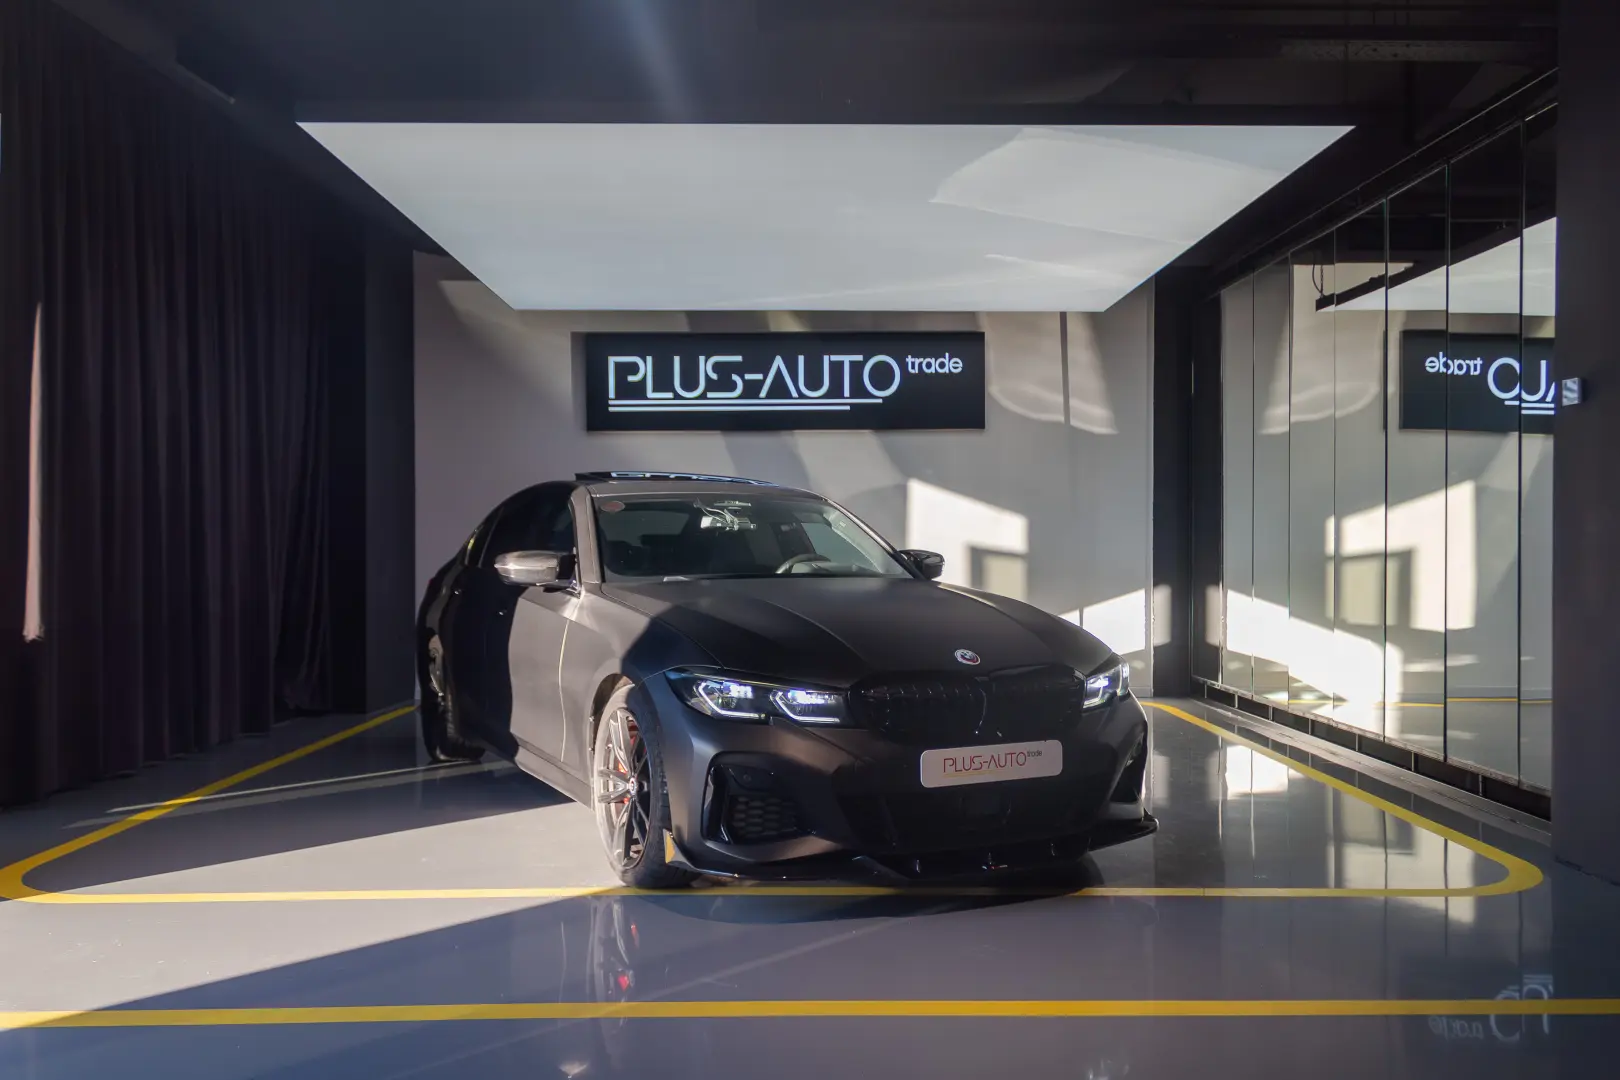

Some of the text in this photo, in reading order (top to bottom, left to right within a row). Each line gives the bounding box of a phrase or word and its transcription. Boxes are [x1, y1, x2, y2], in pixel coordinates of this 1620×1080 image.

[607, 352, 963, 399] PLUS-AUTO trade
[944, 752, 1027, 773] PLUS-AUTO
